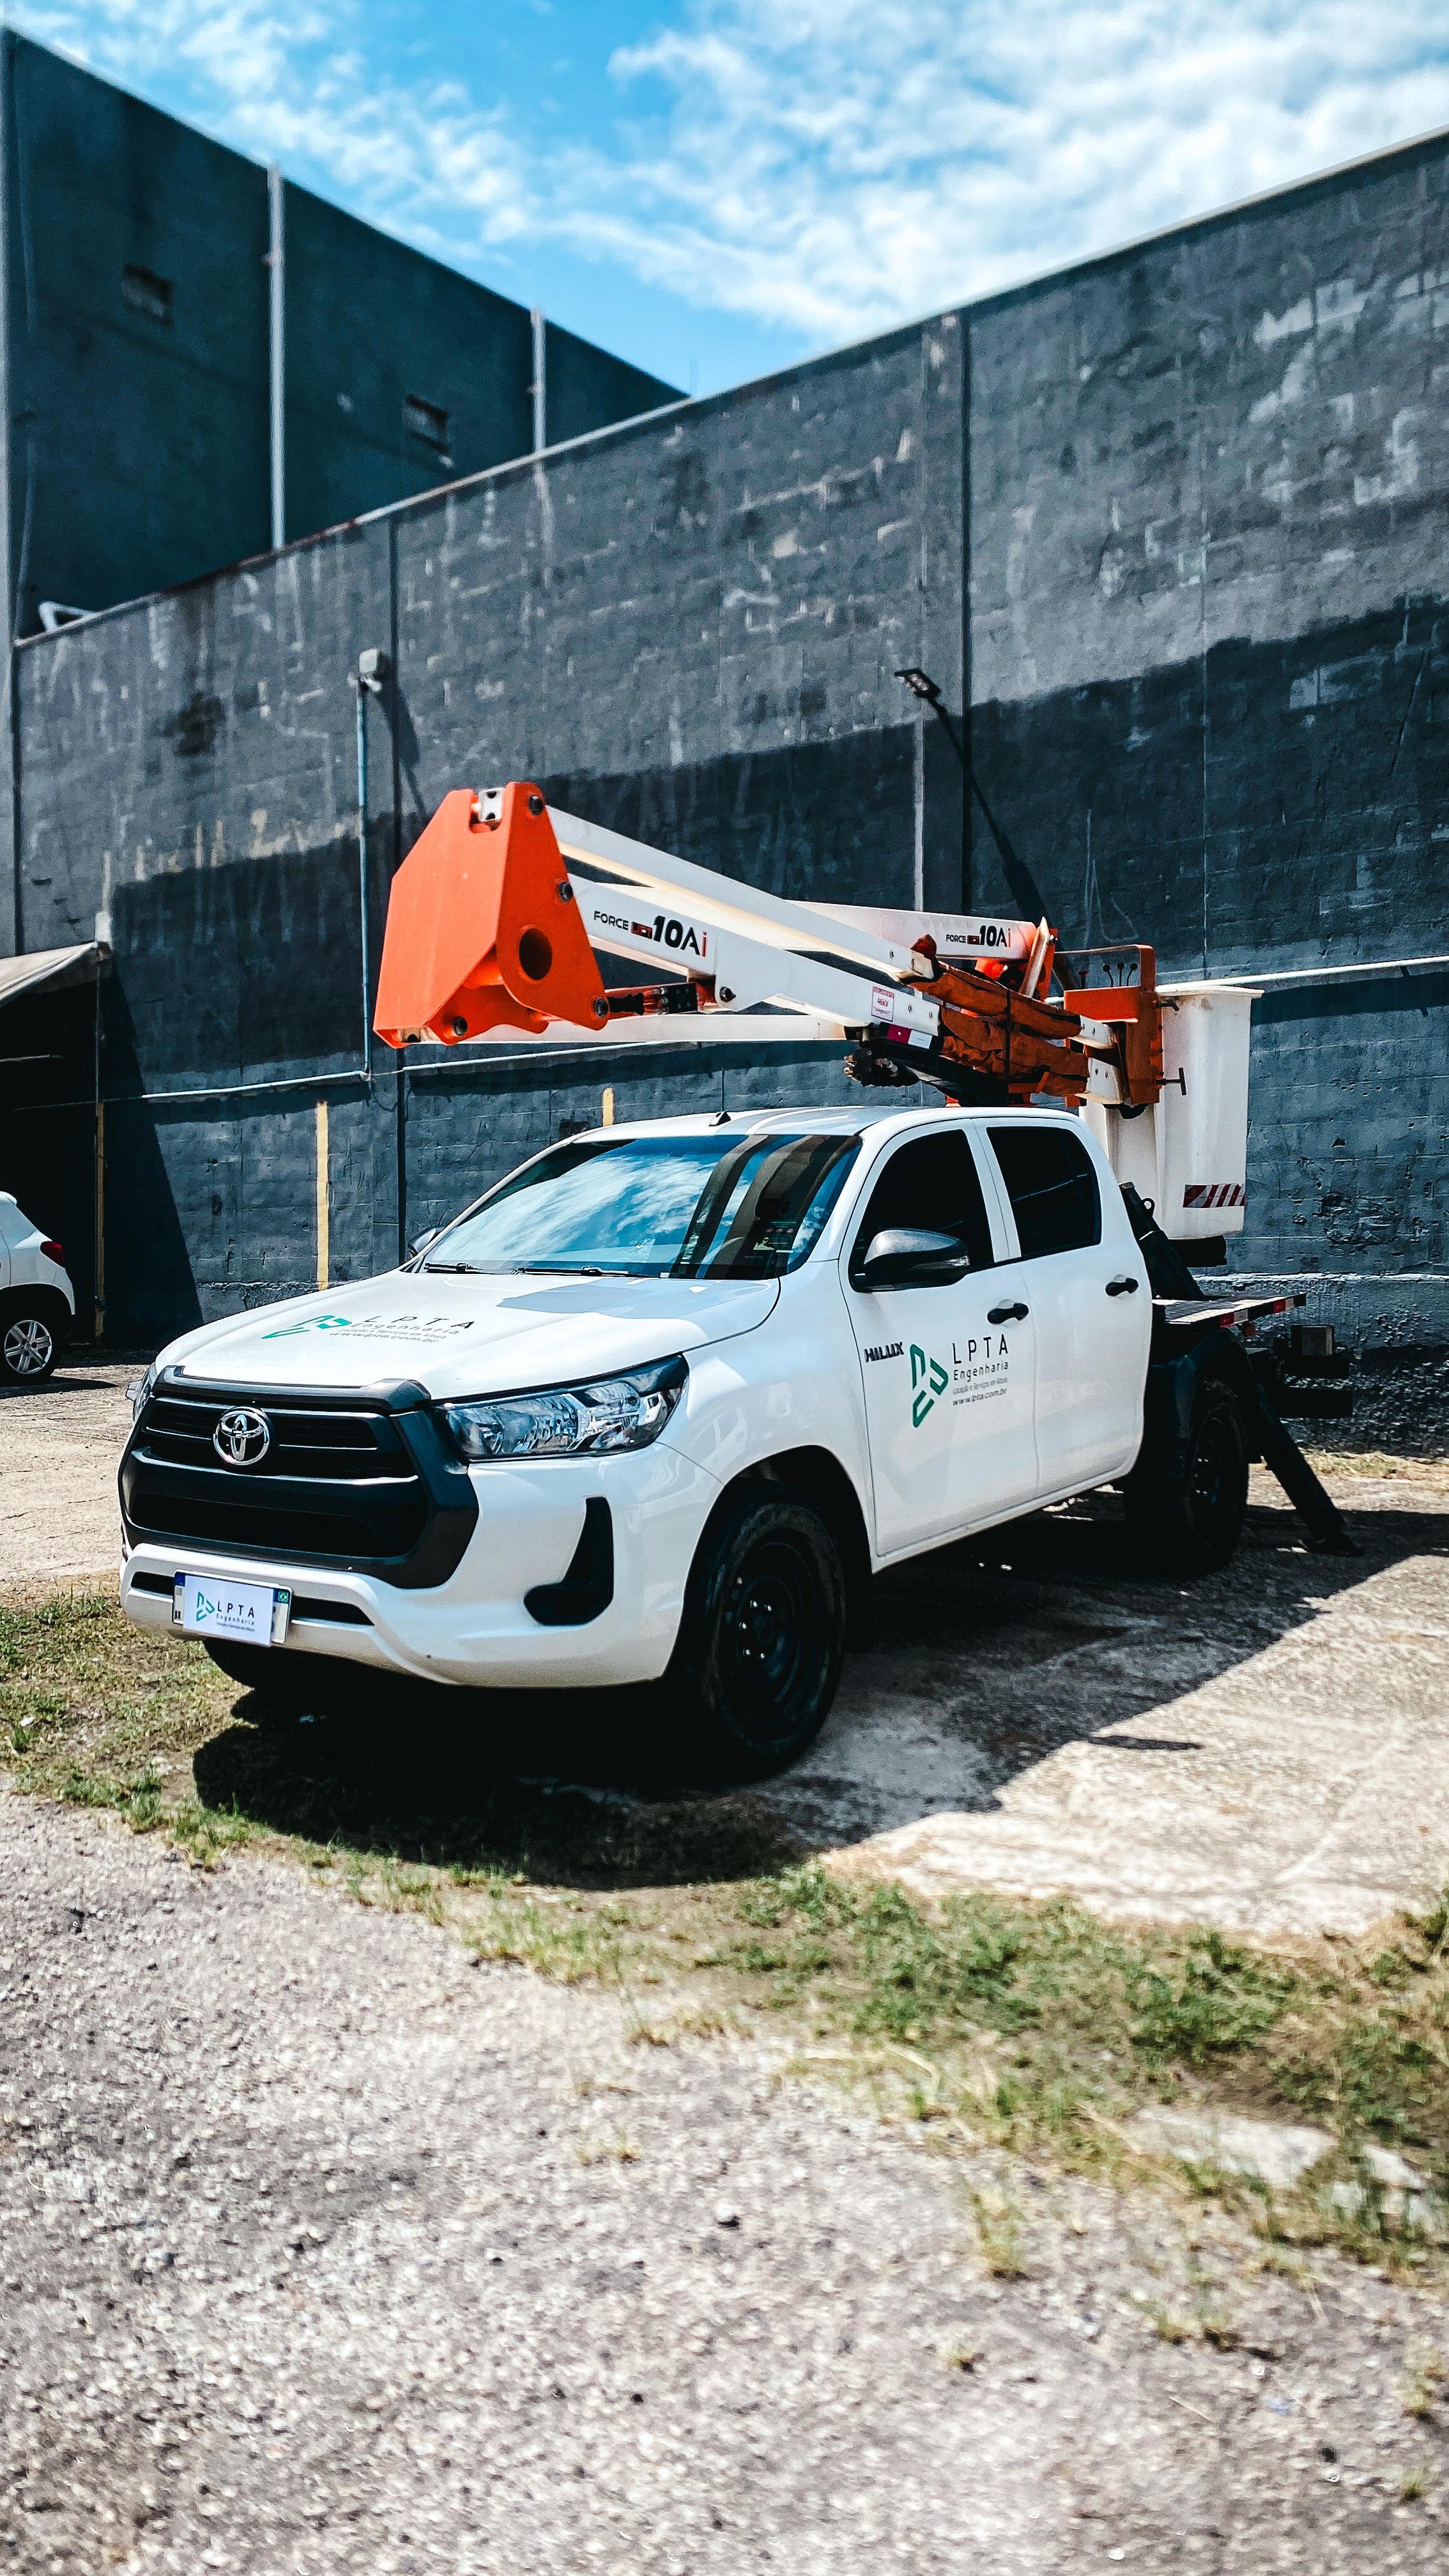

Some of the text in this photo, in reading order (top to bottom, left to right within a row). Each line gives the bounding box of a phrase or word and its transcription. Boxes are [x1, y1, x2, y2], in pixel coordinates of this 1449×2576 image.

[594, 910, 629, 931] FORCE
[653, 915, 707, 957] 10Ai
[946, 934, 966, 943] FORCE
[979, 924, 1011, 947] 10Ai
[349, 1323, 459, 1335] Engenharia
[364, 1315, 475, 1329] LPTA
[864, 1342, 904, 1362] HILUX
[952, 1334, 1008, 1365] LPTA
[953, 1360, 1008, 1382] Engenharia
[217, 1600, 255, 1618] LPTA
